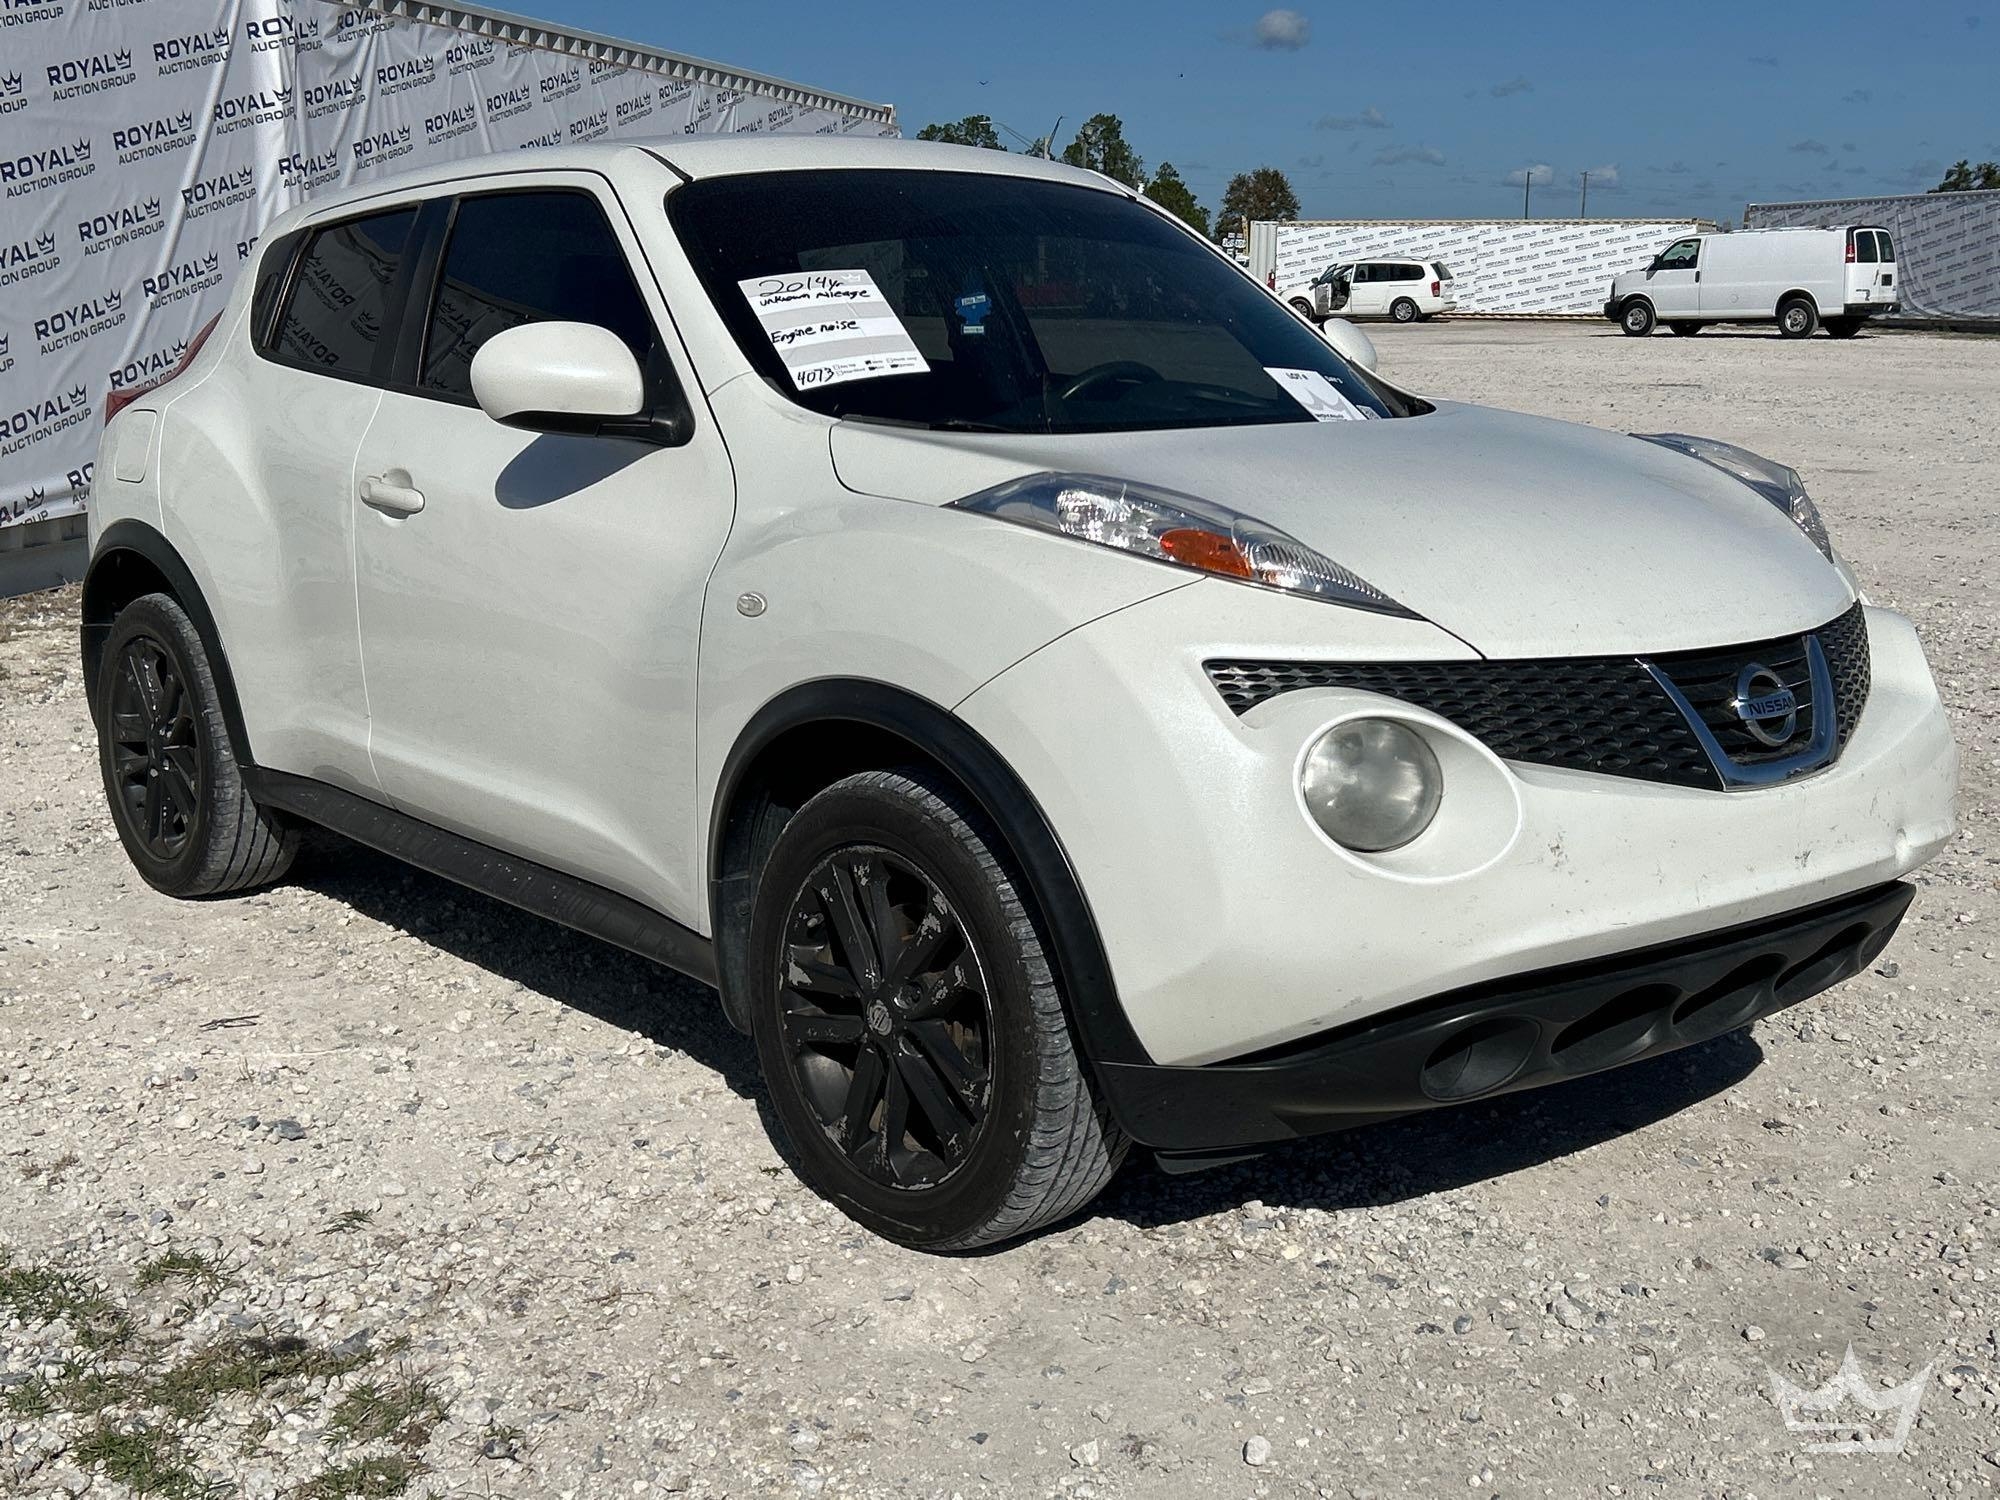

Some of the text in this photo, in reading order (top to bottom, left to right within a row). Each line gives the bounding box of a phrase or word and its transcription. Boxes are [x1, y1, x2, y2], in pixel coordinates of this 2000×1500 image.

[25, 6, 64, 23] GROUP
[153, 33, 215, 61] ROYAL
[251, 36, 296, 53] AUCTIO
[337, 27, 370, 43] AUCTION
[159, 50, 231, 76] AUCTION GROU
[446, 40, 484, 65] ROYAL
[47, 54, 116, 86] ROYAL
[377, 59, 423, 84] ROYAL
[540, 72, 572, 93] ROYAL
[53, 73, 136, 101] AUCTION GROUP
[304, 79, 351, 106] ROYAL
[380, 74, 436, 97] AUCTION GROUP
[659, 82, 684, 98] ROYAL
[214, 91, 275, 122] ROYAL
[307, 103, 340, 119] AUCTION
[487, 90, 522, 112] ROYAL
[489, 102, 532, 124] AUCTION GROUP
[616, 97, 645, 117] ROYAL
[113, 117, 178, 150] ROYAL
[216, 107, 295, 136] AUCTION GROUP
[425, 109, 465, 134] ROYAL
[429, 121, 477, 145] AUCTION GROUP
[570, 115, 601, 137] ROYAL
[119, 134, 196, 165] AUCTION GROUP
[353, 130, 399, 158] ROYAL
[357, 144, 413, 170] AUCTION GROUP
[1, 149, 75, 182] ROYAL
[315, 169, 341, 187] GROUP
[7, 163, 96, 198] AUCTION GROUP
[181, 173, 240, 206] ROYAL
[186, 188, 256, 220] AUCTION GROUP
[78, 208, 146, 241] ROYAL
[84, 220, 165, 257] AUCTION GROUP
[22, 258, 60, 278] GROUP
[143, 260, 205, 297] ROYAL
[150, 274, 223, 311] AUCTION GROUP
[34, 298, 106, 341] ROYAL
[771, 320, 860, 344] Engine noise
[41, 313, 126, 356] AUCTION GROUP
[110, 348, 175, 390] ROYAL
[797, 367, 835, 386] 4073
[0, 395, 70, 441] ROYAL
[2, 407, 91, 458] AUCTION GROUP
